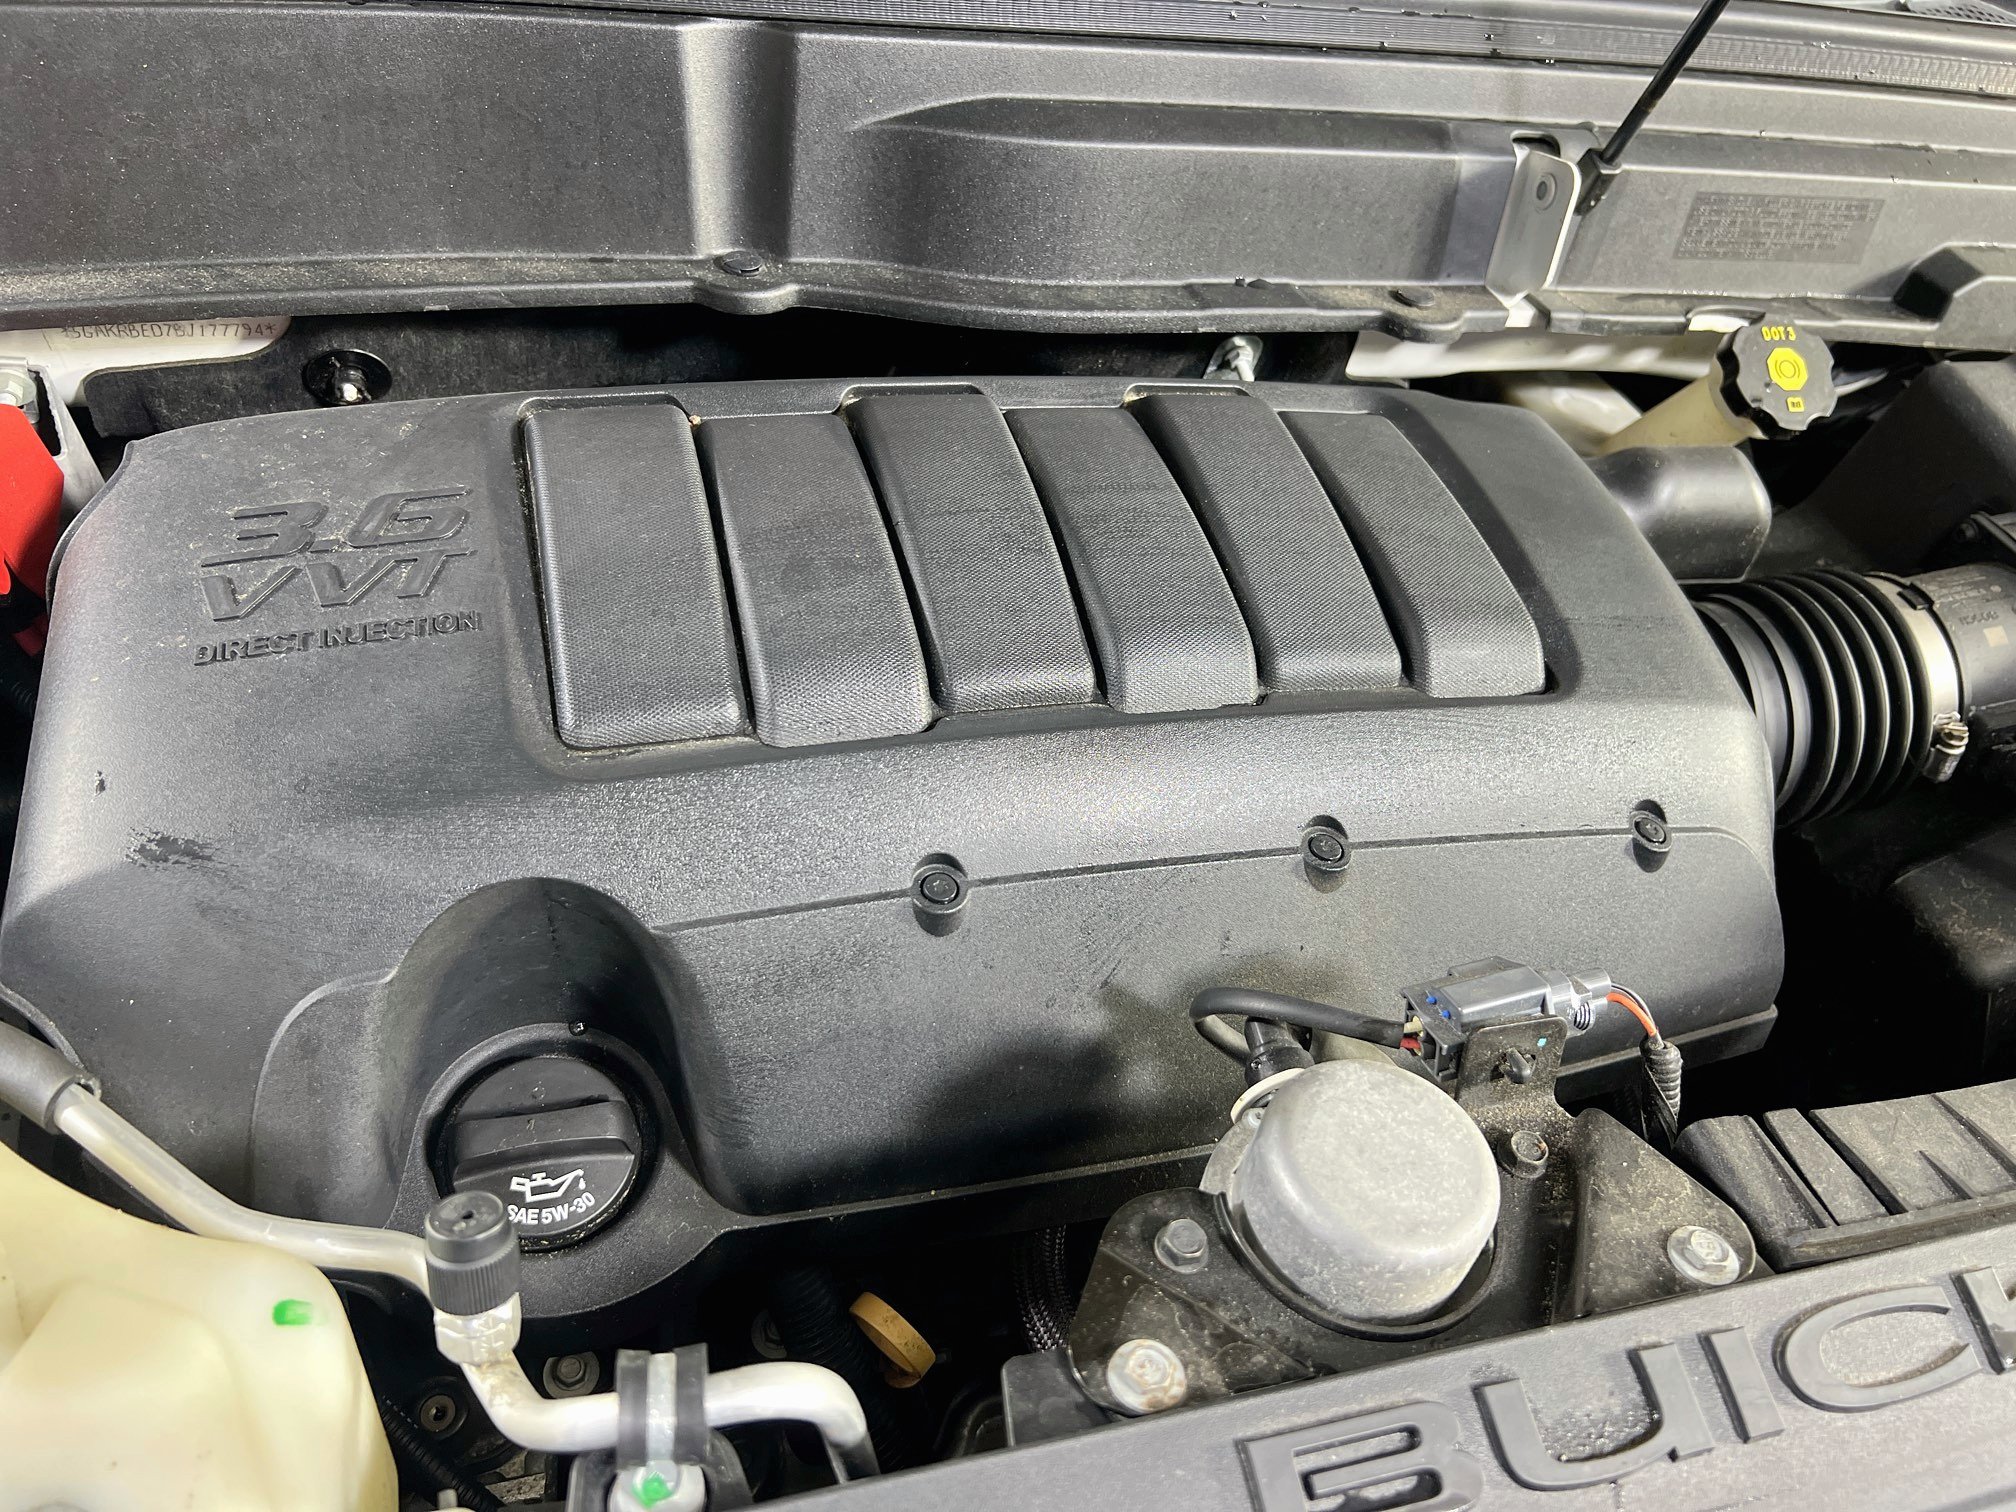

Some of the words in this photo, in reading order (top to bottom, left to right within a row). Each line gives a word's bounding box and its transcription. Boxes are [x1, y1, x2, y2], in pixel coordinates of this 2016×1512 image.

[1762, 326, 1785, 341] DOT
[1786, 326, 1797, 341] 3
[201, 485, 472, 568] 3.6
[200, 549, 478, 621] VVT
[193, 630, 315, 666] DIRECT
[318, 610, 483, 650] INJECTION
[507, 1204, 540, 1225] SAE
[541, 1191, 596, 1225] 5W-30
